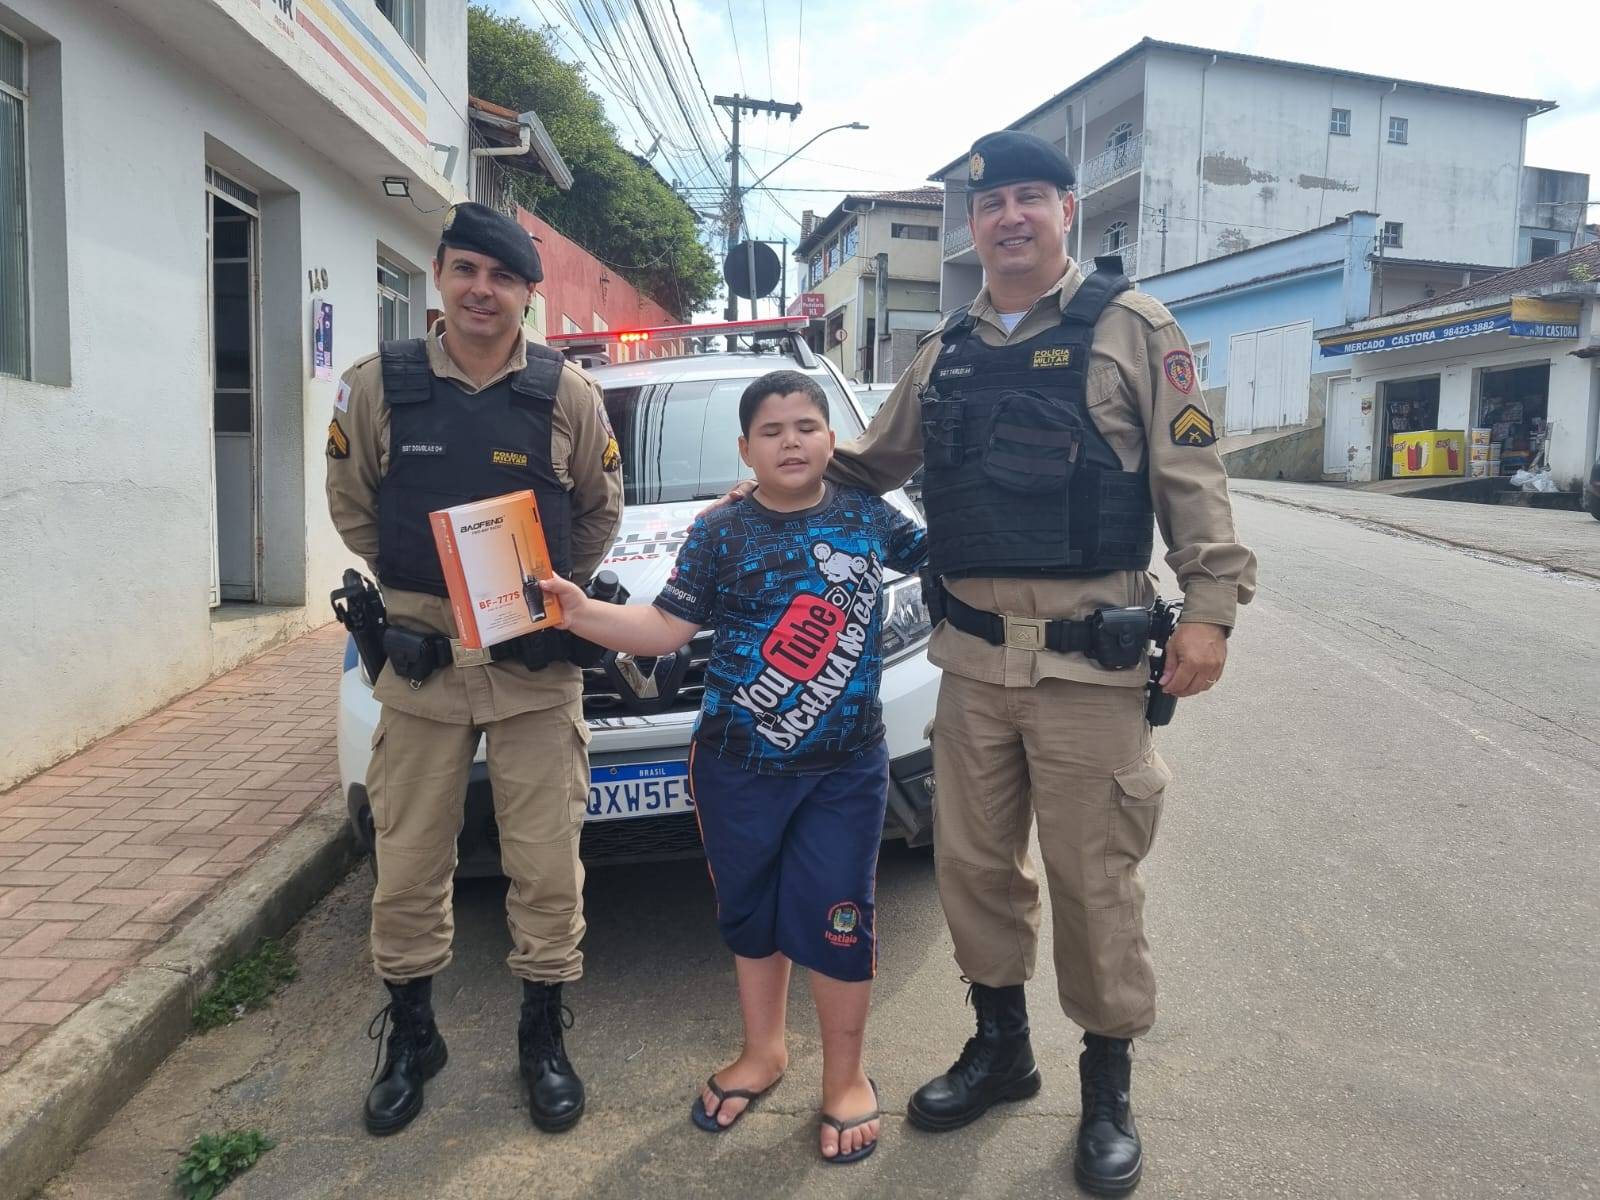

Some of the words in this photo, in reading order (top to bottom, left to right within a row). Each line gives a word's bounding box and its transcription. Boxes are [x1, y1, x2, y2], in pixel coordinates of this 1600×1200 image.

[1344, 339, 1385, 353] MERCADO
[1391, 330, 1436, 346] CASTORA
[1443, 320, 1495, 337] 98423-3882
[1545, 325, 1577, 337] CASTORA
[1033, 356, 1069, 364] MILITAR
[493, 455, 528, 464] MILITAR
[460, 516, 504, 533] BAOFENG
[479, 590, 521, 610] BF-777S
[770, 603, 837, 670] Tube
[639, 768, 666, 777] BRASIL
